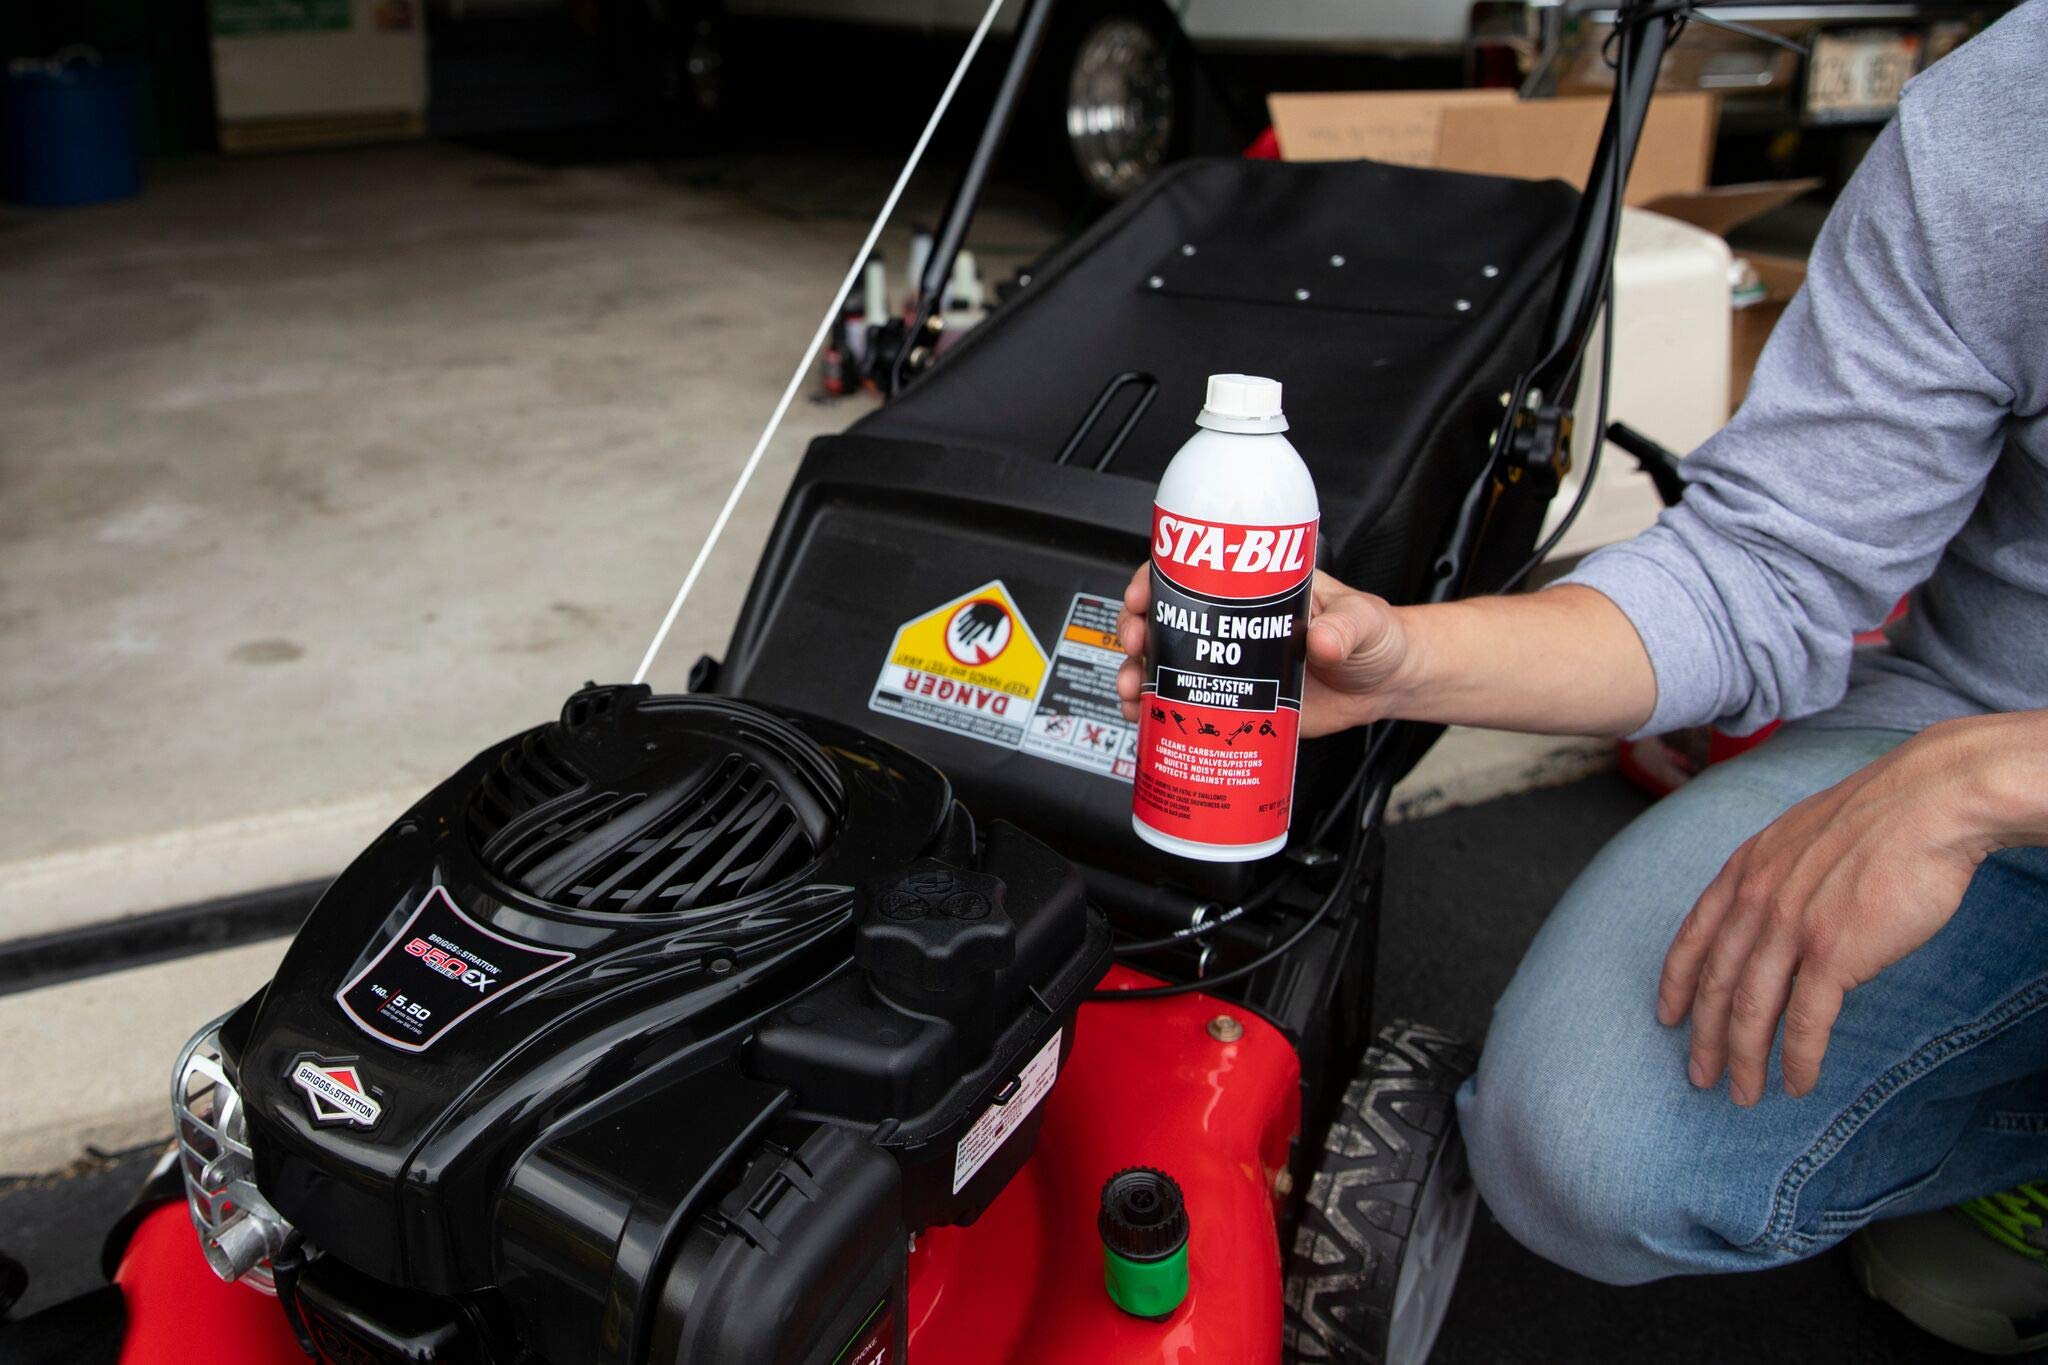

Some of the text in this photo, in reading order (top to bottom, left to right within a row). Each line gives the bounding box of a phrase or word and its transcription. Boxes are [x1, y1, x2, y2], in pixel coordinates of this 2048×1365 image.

[1155, 516, 1307, 573] STA-BIL
[1156, 600, 1293, 640] SMALL ENGINE
[1196, 638, 1242, 666] PRO
[904, 670, 1010, 716] DANGER
[1177, 674, 1254, 695] MULTI-SYSTEM
[1188, 689, 1240, 708] ADDITIVE
[1156, 744, 1262, 768] LUBRICATES VALVES/PISTONS
[1160, 738, 1258, 759] CLEANS CARBS/INJECTORS
[1154, 762, 1188, 780] PROTECTS
[1190, 774, 1224, 785] AGAINST
[1226, 778, 1260, 786] ETHANOL
[1164, 757, 1250, 777] QUIETS NOISY ENGINES
[392, 994, 431, 1020] 5.50
[300, 1068, 374, 1118] BRIGGS&STRATTON
